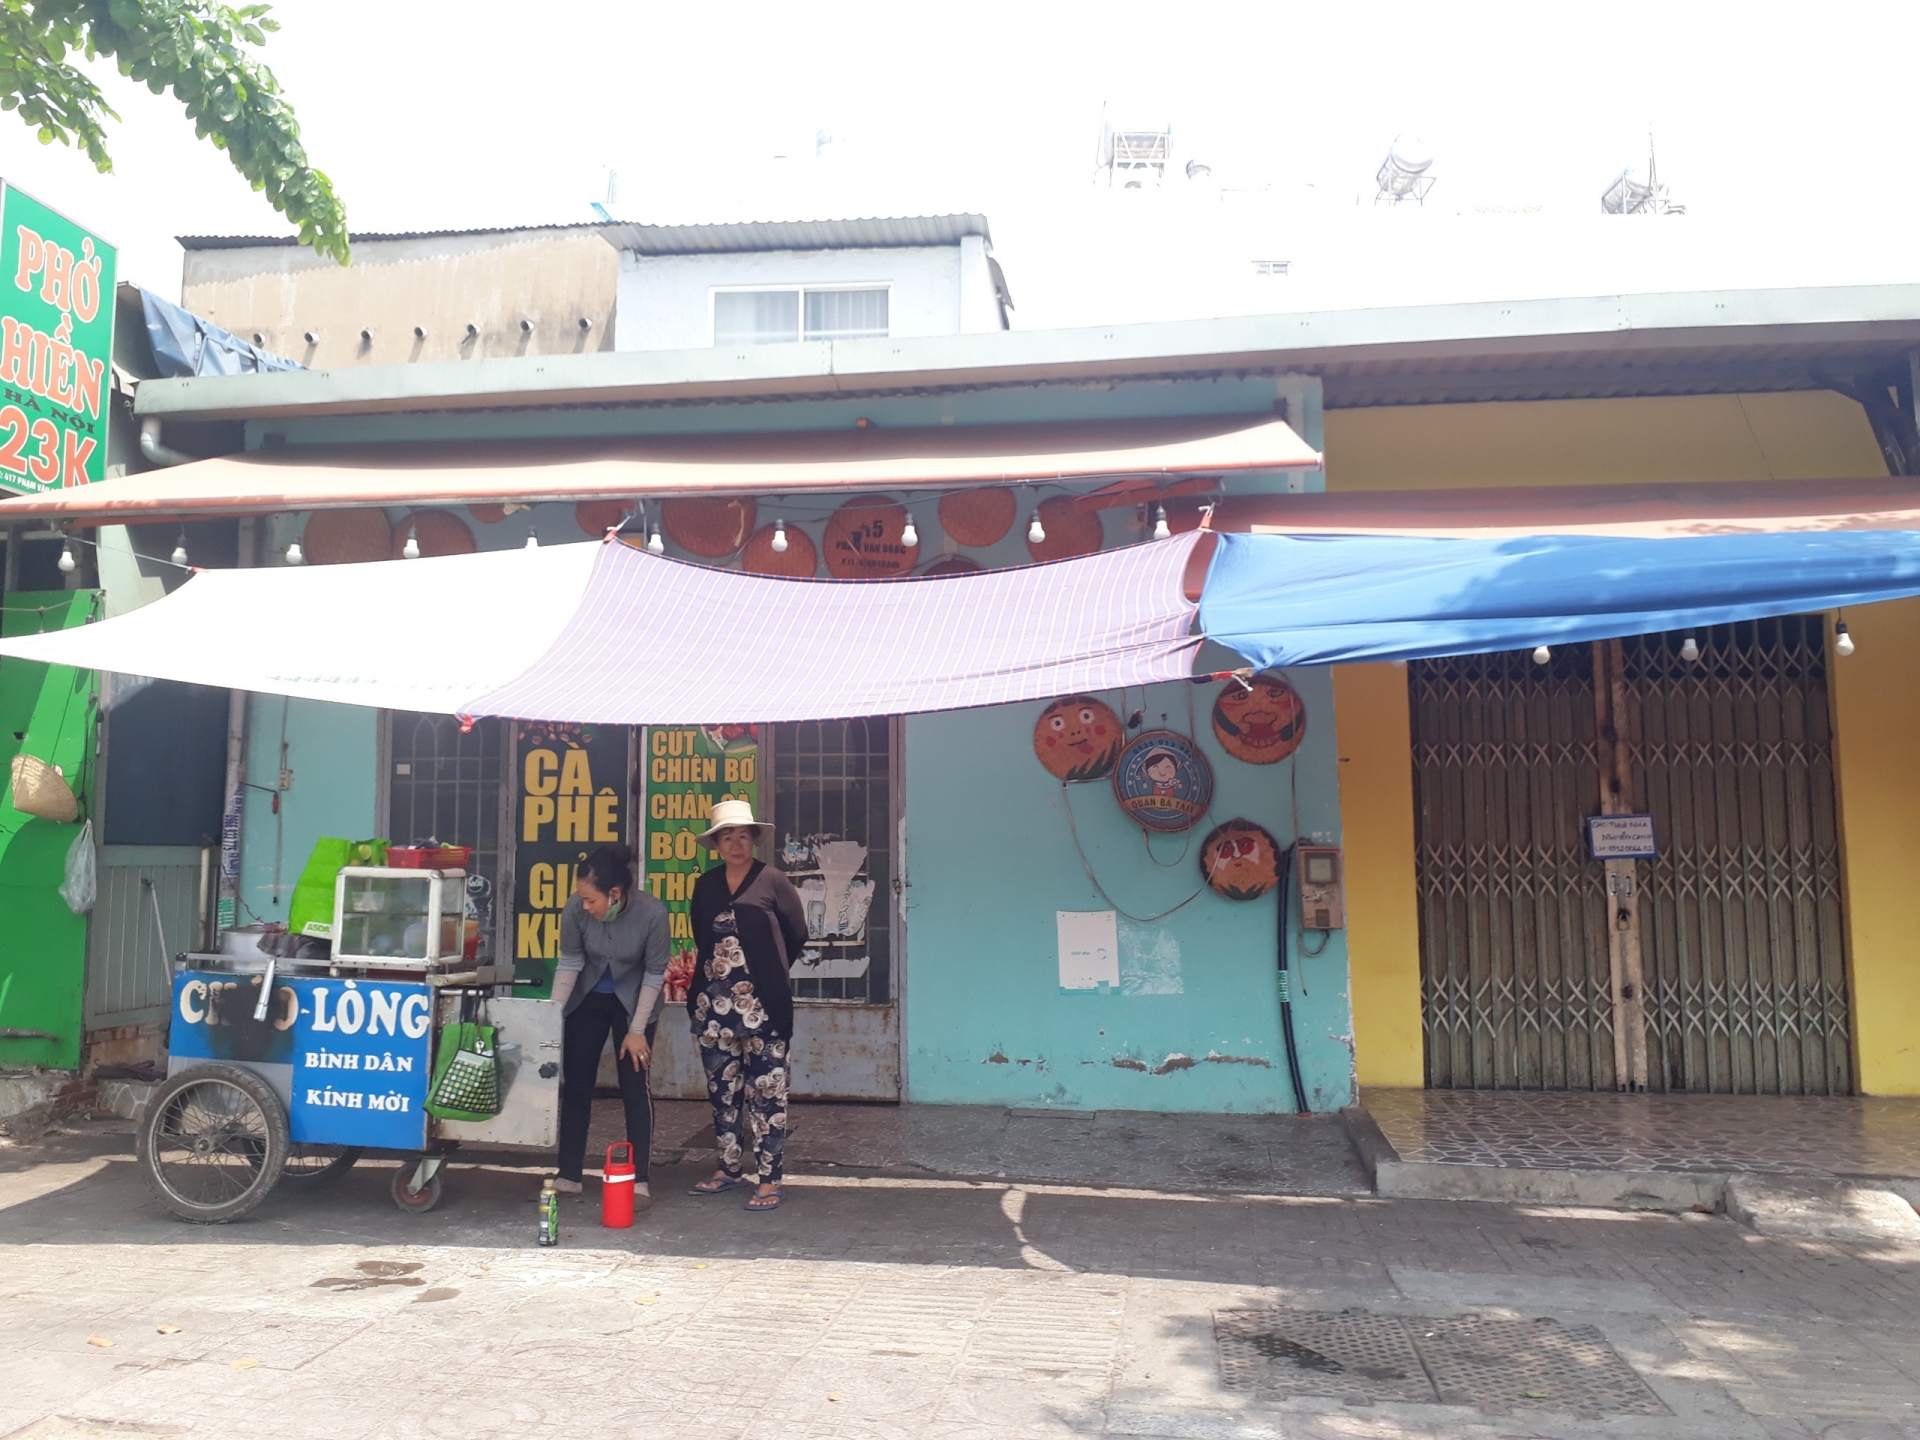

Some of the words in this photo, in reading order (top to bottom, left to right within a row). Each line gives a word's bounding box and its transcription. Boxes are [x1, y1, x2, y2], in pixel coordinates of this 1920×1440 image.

[15, 224, 102, 324] PHỞ
[4, 388, 43, 414] HÀ
[50, 408, 96, 434] NỘI
[0, 405, 97, 488] 23K
[652, 727, 696, 756] CÚT
[524, 741, 593, 796] CÀ
[652, 753, 716, 783] CHIÊN
[724, 754, 756, 783] BƠ
[523, 787, 618, 842] PHÊ
[651, 789, 713, 820] CHÂN
[650, 827, 697, 860] BÒ
[305, 1047, 360, 1071] BÌNH
[363, 1051, 413, 1072] DÂN
[306, 1085, 364, 1110] KÍNH
[367, 1089, 411, 1113] MỜI
